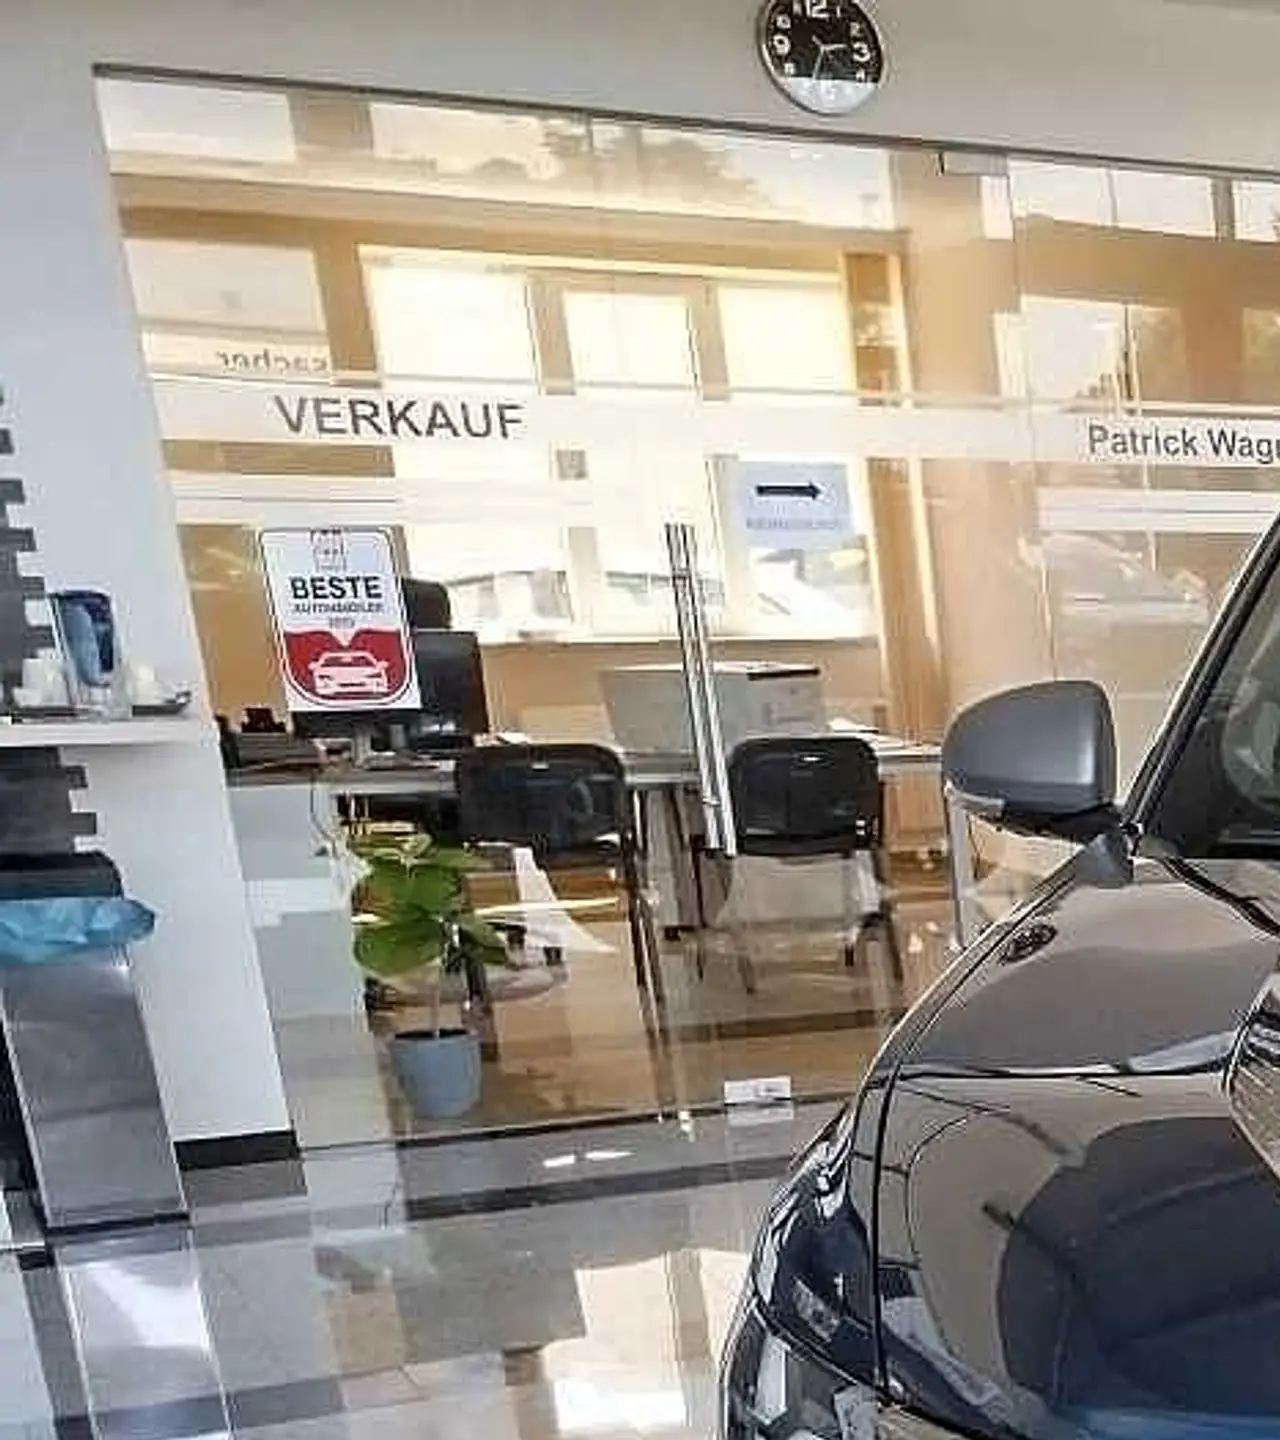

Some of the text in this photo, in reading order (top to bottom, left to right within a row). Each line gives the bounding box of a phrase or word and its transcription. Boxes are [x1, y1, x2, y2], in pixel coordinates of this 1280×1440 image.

[852, 41, 871, 61] 3
[274, 395, 524, 438] VERKAUF
[1087, 424, 1198, 456] Patrick
[290, 574, 383, 600] BESTE
